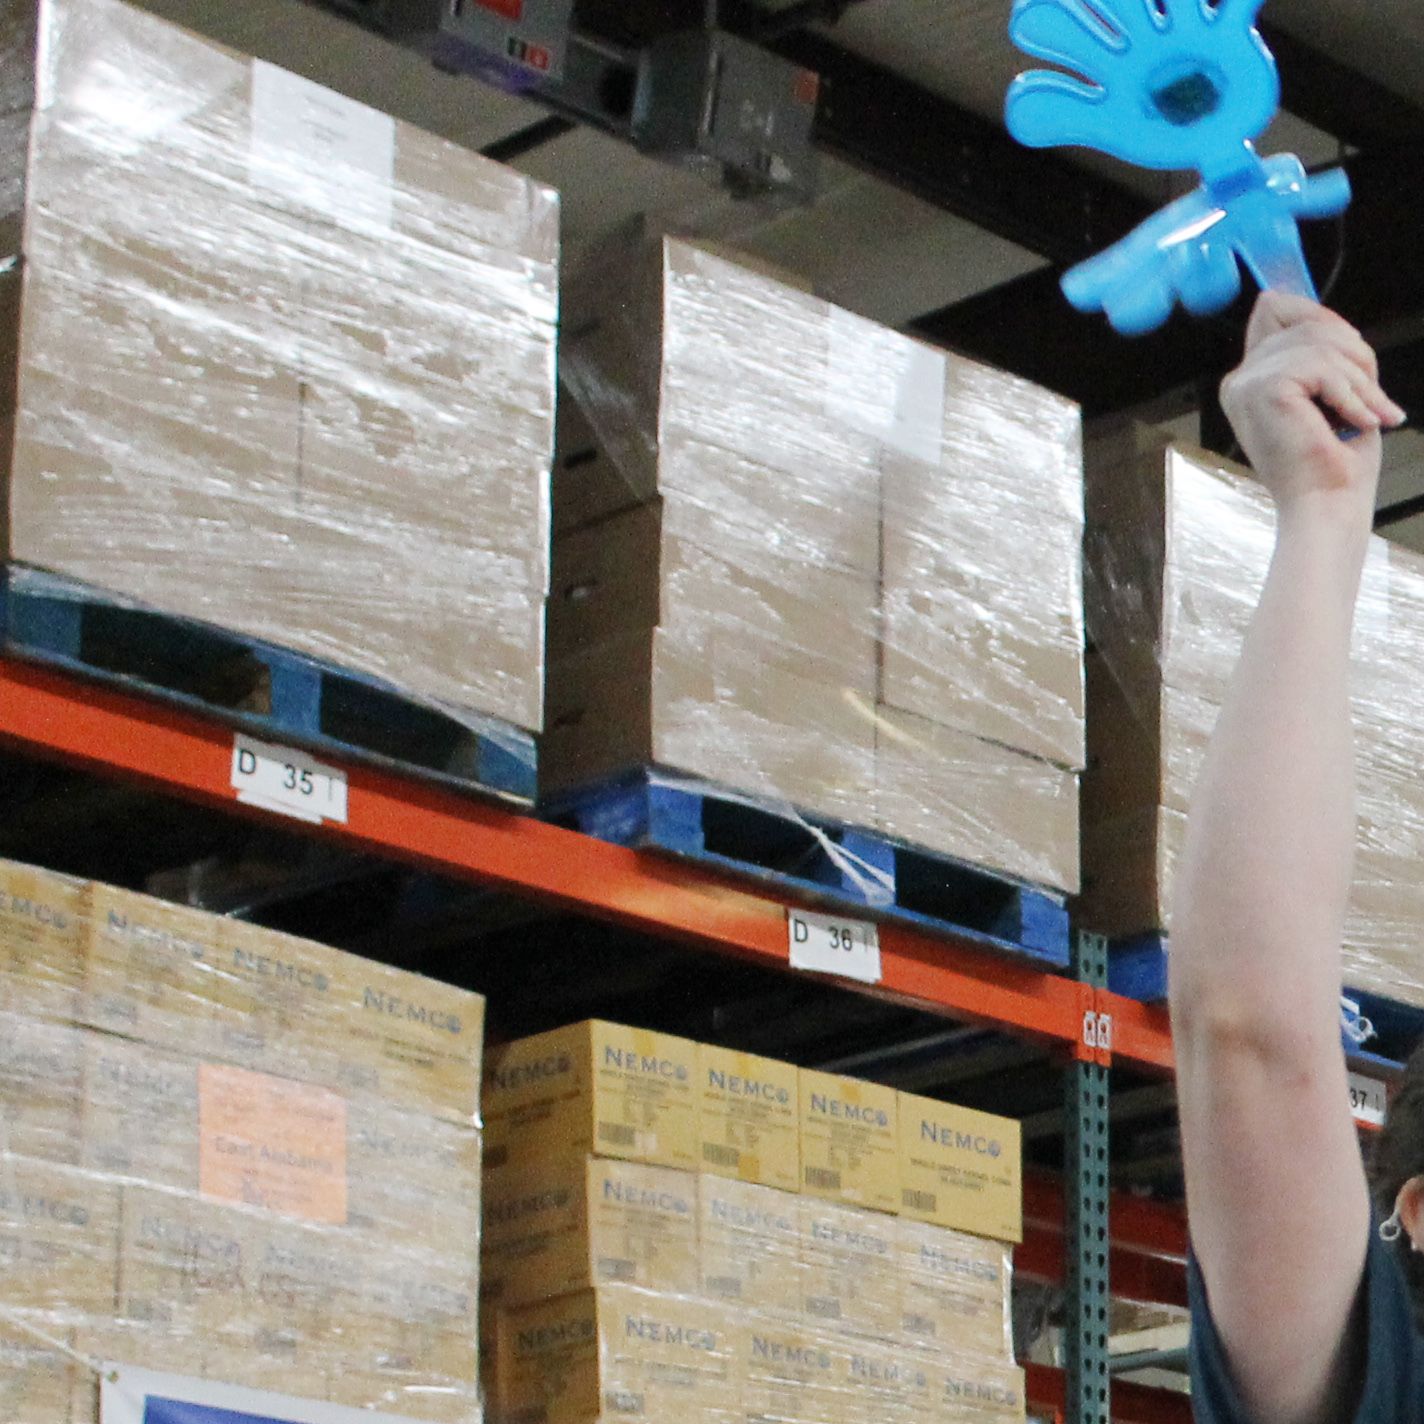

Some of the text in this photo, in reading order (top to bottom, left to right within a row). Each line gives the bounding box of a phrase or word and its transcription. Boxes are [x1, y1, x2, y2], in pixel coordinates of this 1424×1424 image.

[239, 748, 313, 795] D 35
[794, 918, 853, 952] D 36
[363, 986, 463, 1034] NEMCO
[604, 1045, 688, 1081] NEMCO
[708, 1068, 789, 1104] NEMCO
[810, 1093, 888, 1127] NEMCO
[920, 1120, 1001, 1157] NEMCO
[603, 1178, 688, 1213] NEMCO
[625, 1315, 716, 1350] NEMCO
[752, 1335, 831, 1369] NEMCO
